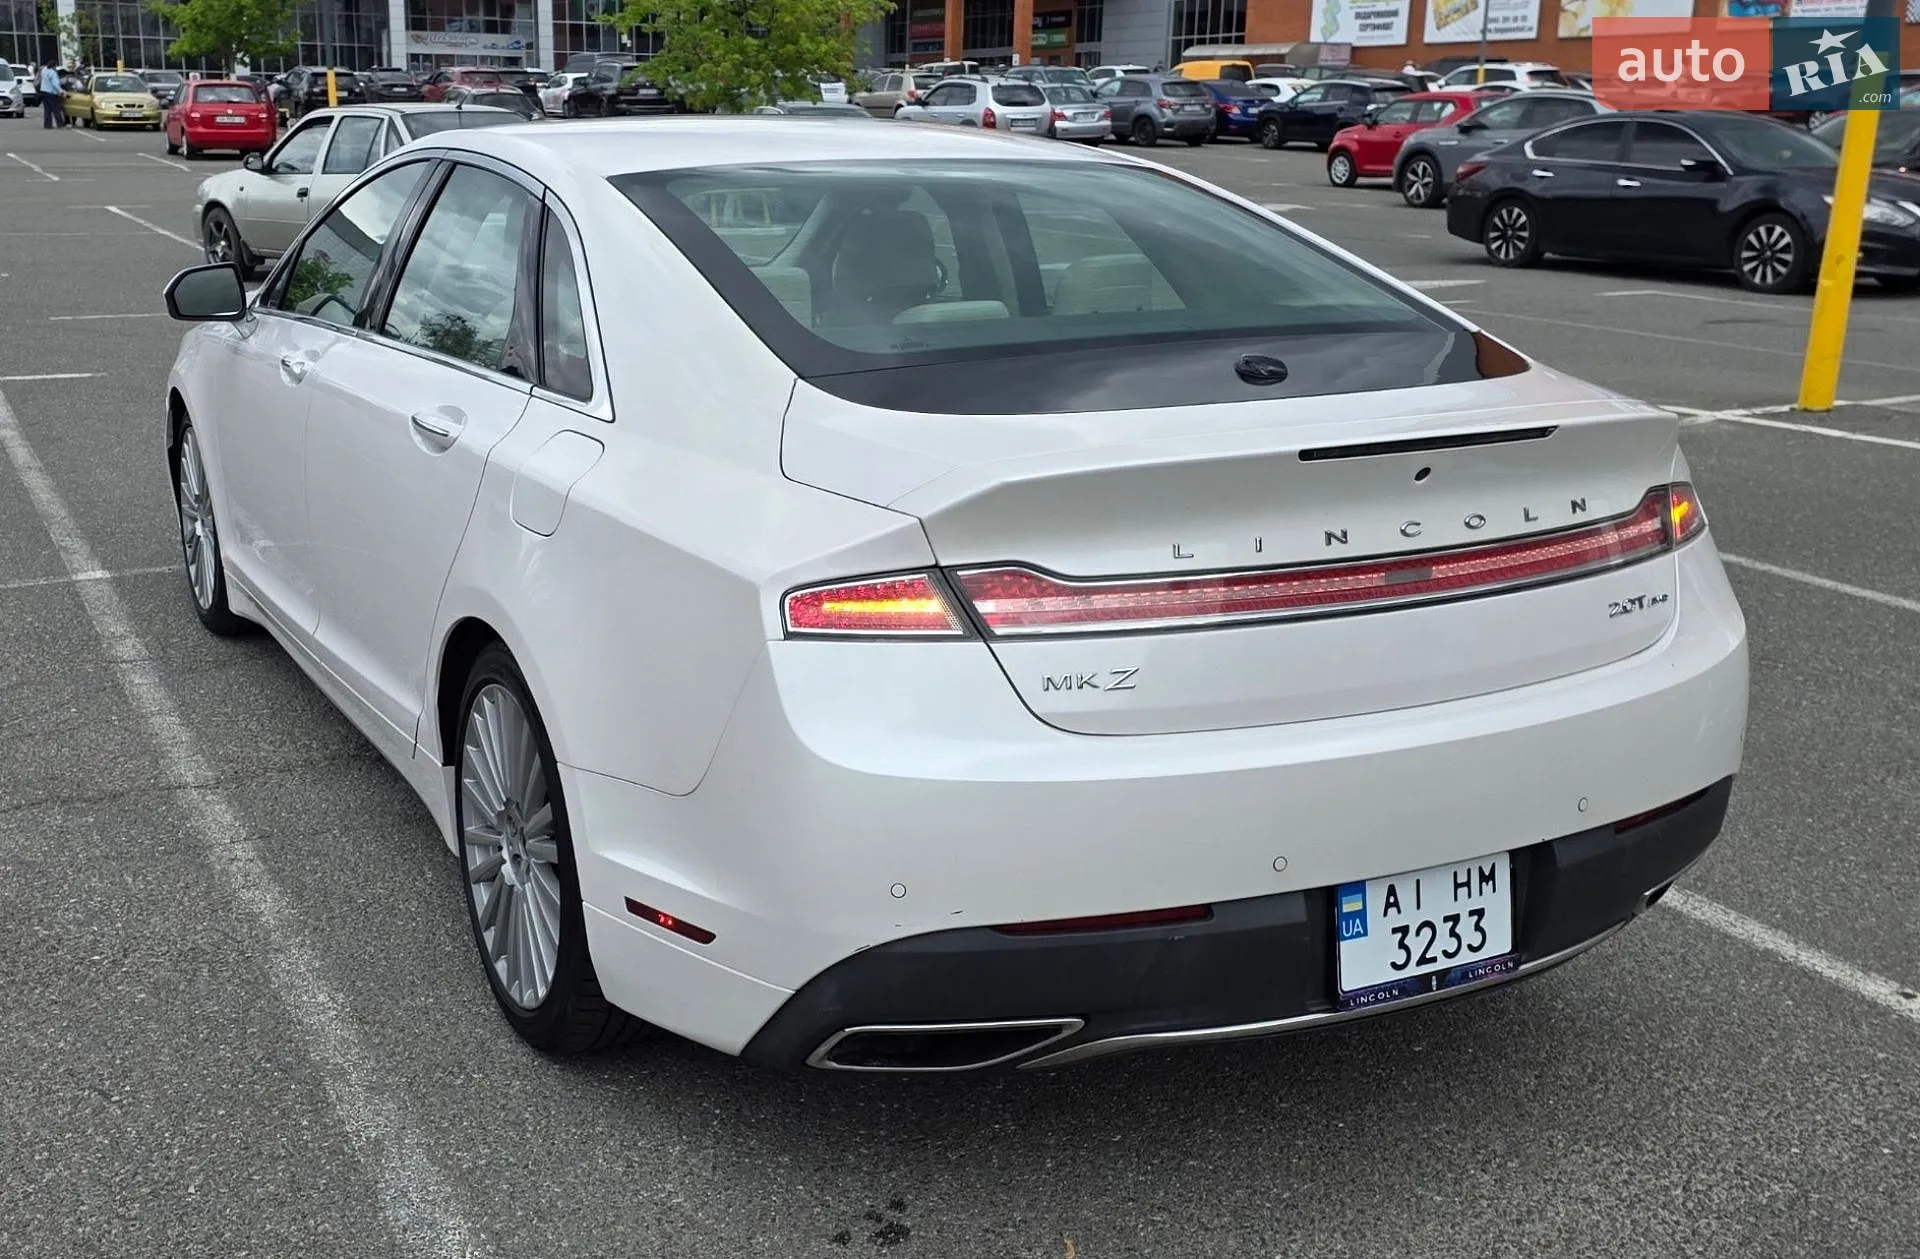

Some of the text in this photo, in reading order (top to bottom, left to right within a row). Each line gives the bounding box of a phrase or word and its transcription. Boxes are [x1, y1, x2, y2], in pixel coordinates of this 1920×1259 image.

[1173, 497, 1587, 559] LINCOLN
[1043, 666, 1140, 692] MKZ
[1453, 862, 1497, 902] HM
[1342, 918, 1364, 937] UA
[1390, 907, 1487, 971] 3233
[1468, 961, 1514, 978] LINCOLN
[1350, 988, 1399, 1006] LINCOLN
